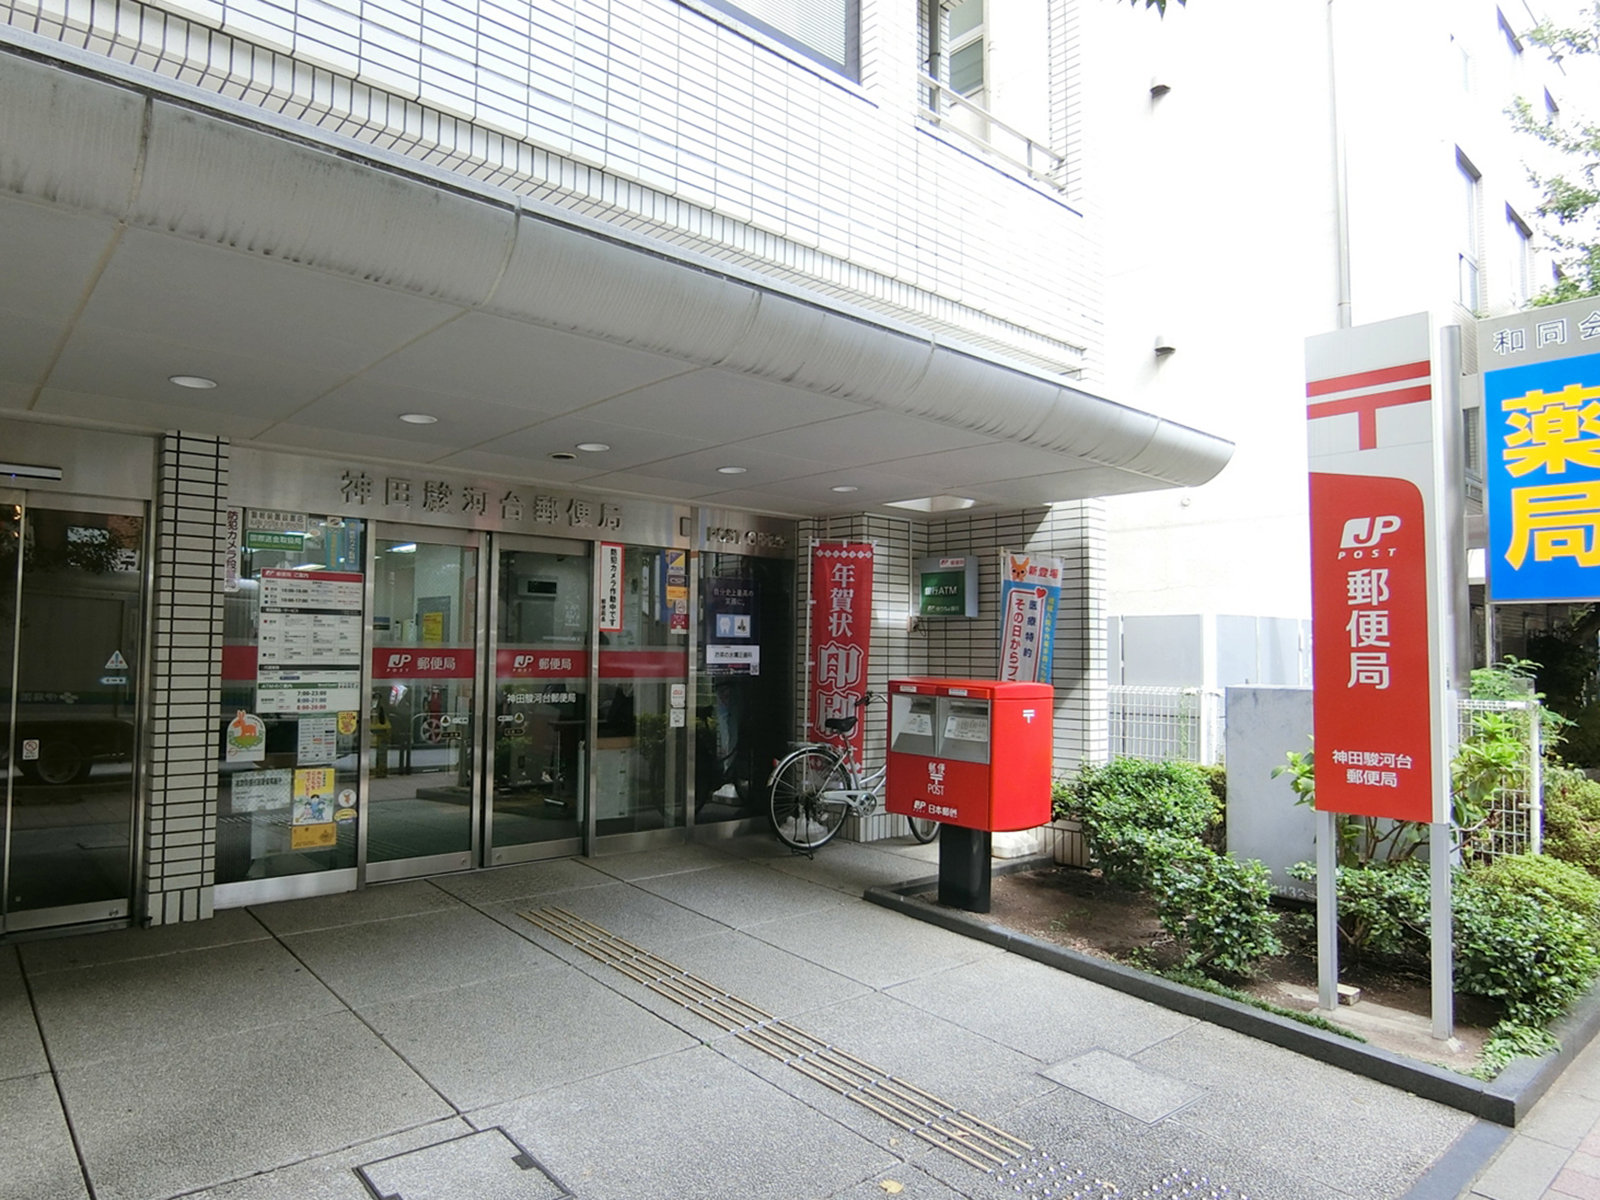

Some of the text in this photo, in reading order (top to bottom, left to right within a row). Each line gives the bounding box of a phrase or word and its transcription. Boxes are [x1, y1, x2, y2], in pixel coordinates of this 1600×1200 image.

[1493, 311, 1600, 355] 和同会
[341, 471, 623, 531] 神田駿河台郵便局
[1341, 514, 1402, 550] JP
[1337, 547, 1397, 560] POST
[1028, 566, 1059, 579] 新登場
[924, 585, 958, 596] 銀行ATM
[828, 562, 856, 638] 年賀状
[1023, 600, 1038, 658] 医療特約
[1346, 568, 1391, 690] 郵便局
[416, 656, 456, 671] 郵便局
[538, 657, 572, 671] 郵便局
[506, 692, 577, 704] 神田駿河台郵便局
[1332, 749, 1413, 770] 神田駿河台
[1346, 768, 1398, 788] 郵便局
[927, 783, 945, 796] POST
[928, 804, 958, 818] 日本郵便
